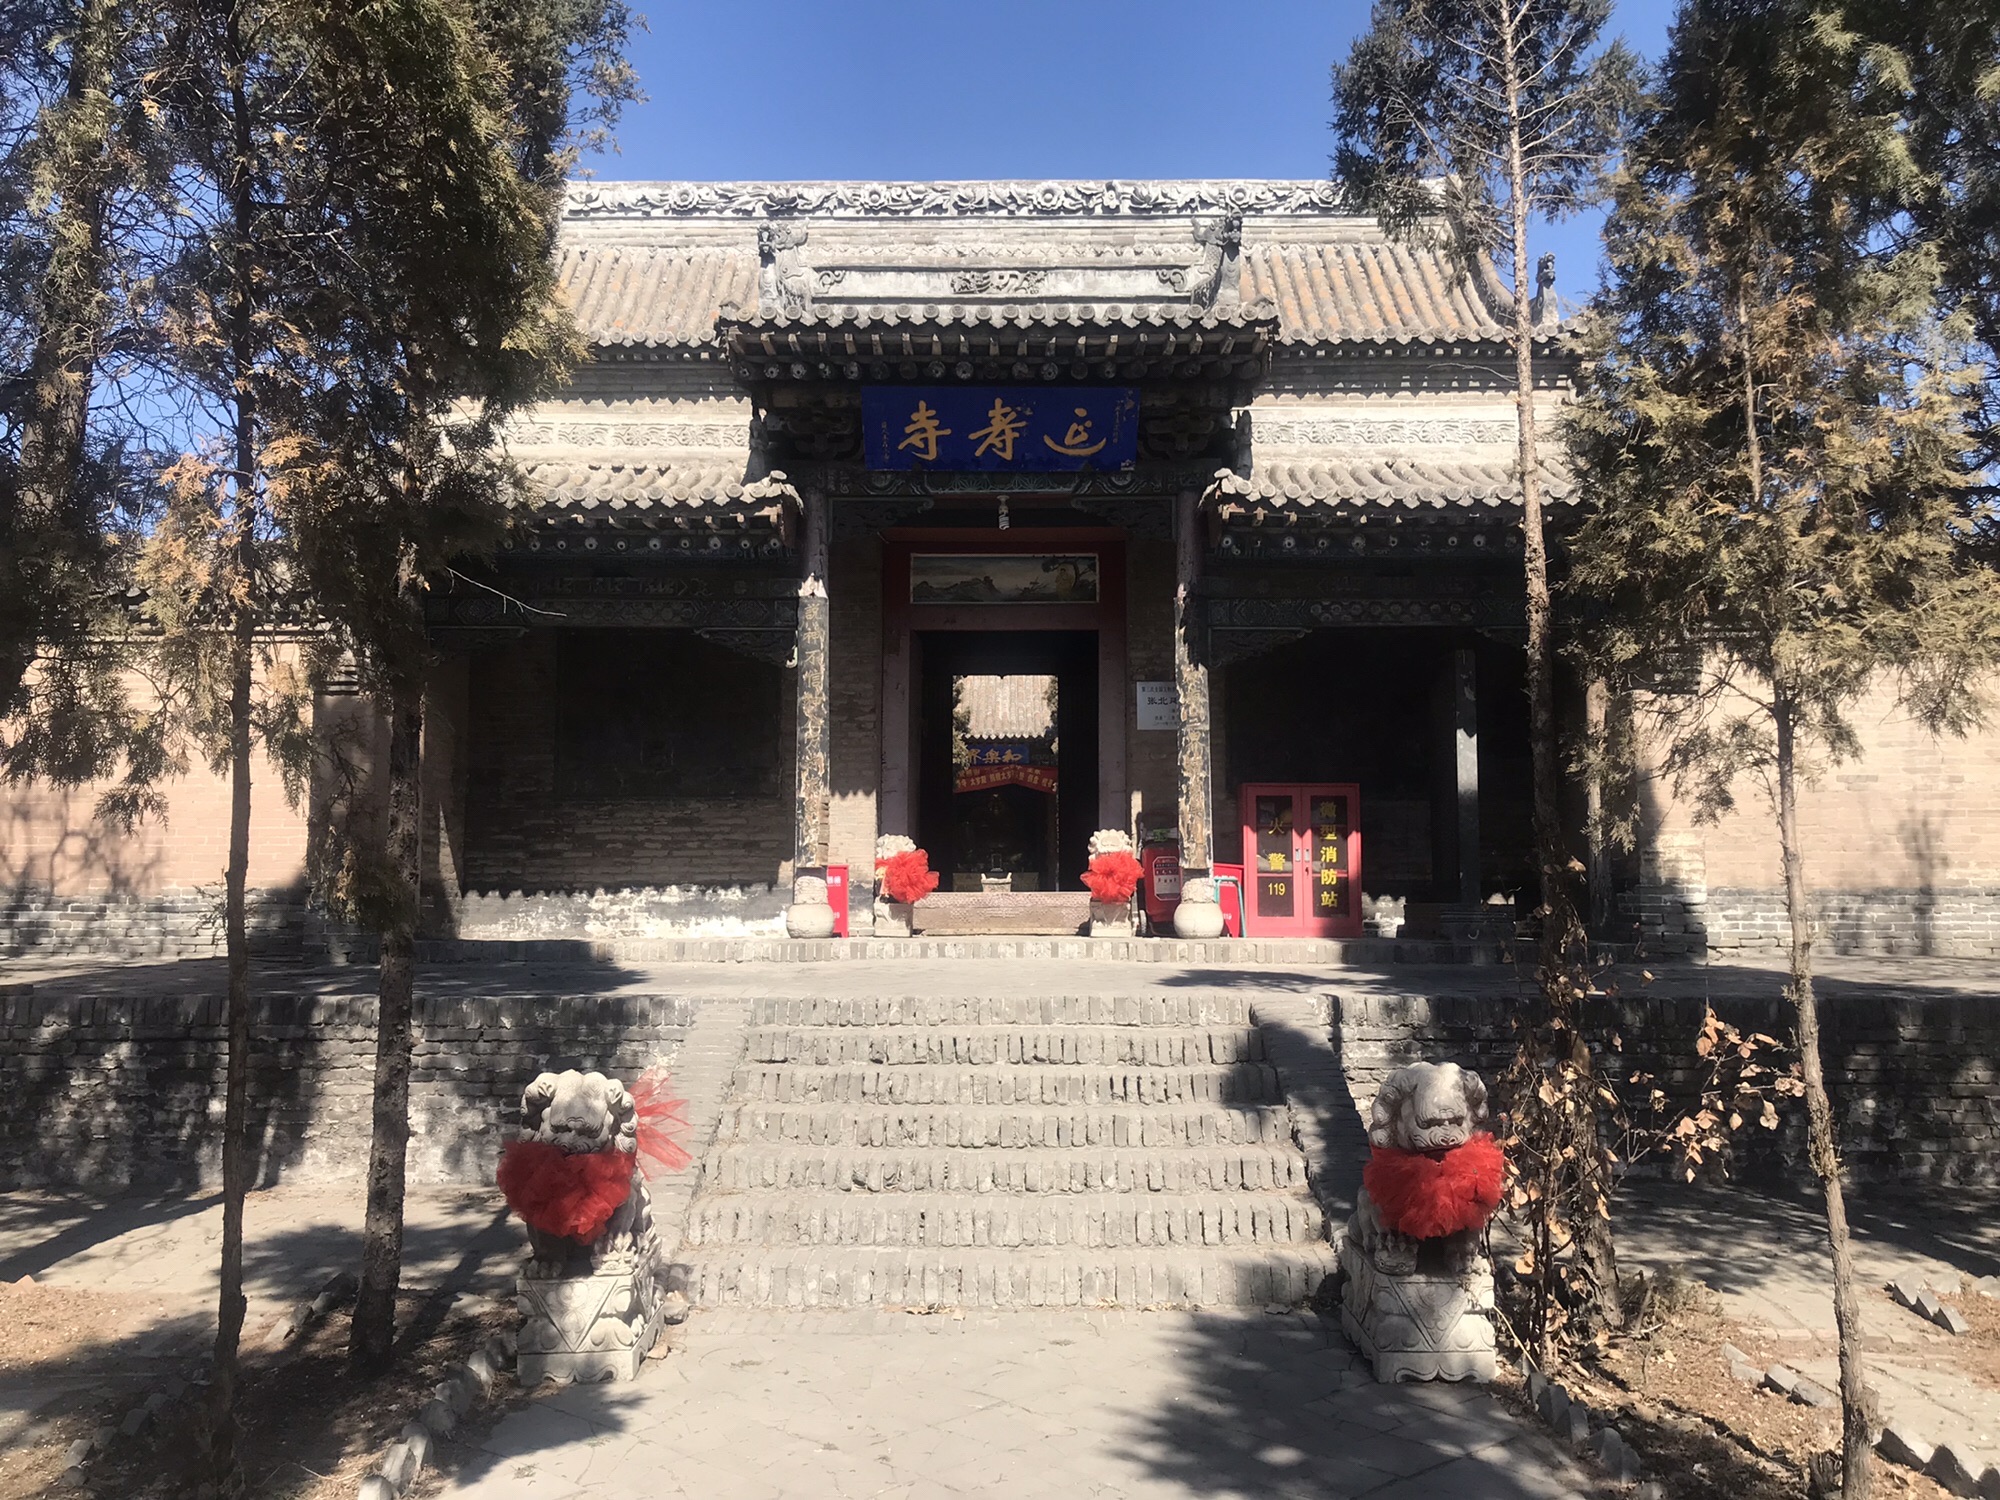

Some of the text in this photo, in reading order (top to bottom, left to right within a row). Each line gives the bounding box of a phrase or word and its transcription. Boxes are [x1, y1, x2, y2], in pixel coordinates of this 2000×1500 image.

[1268, 817, 1286, 871] 火警
[1320, 802, 1338, 908] 微型消防站
[1268, 883, 1286, 896] 119
